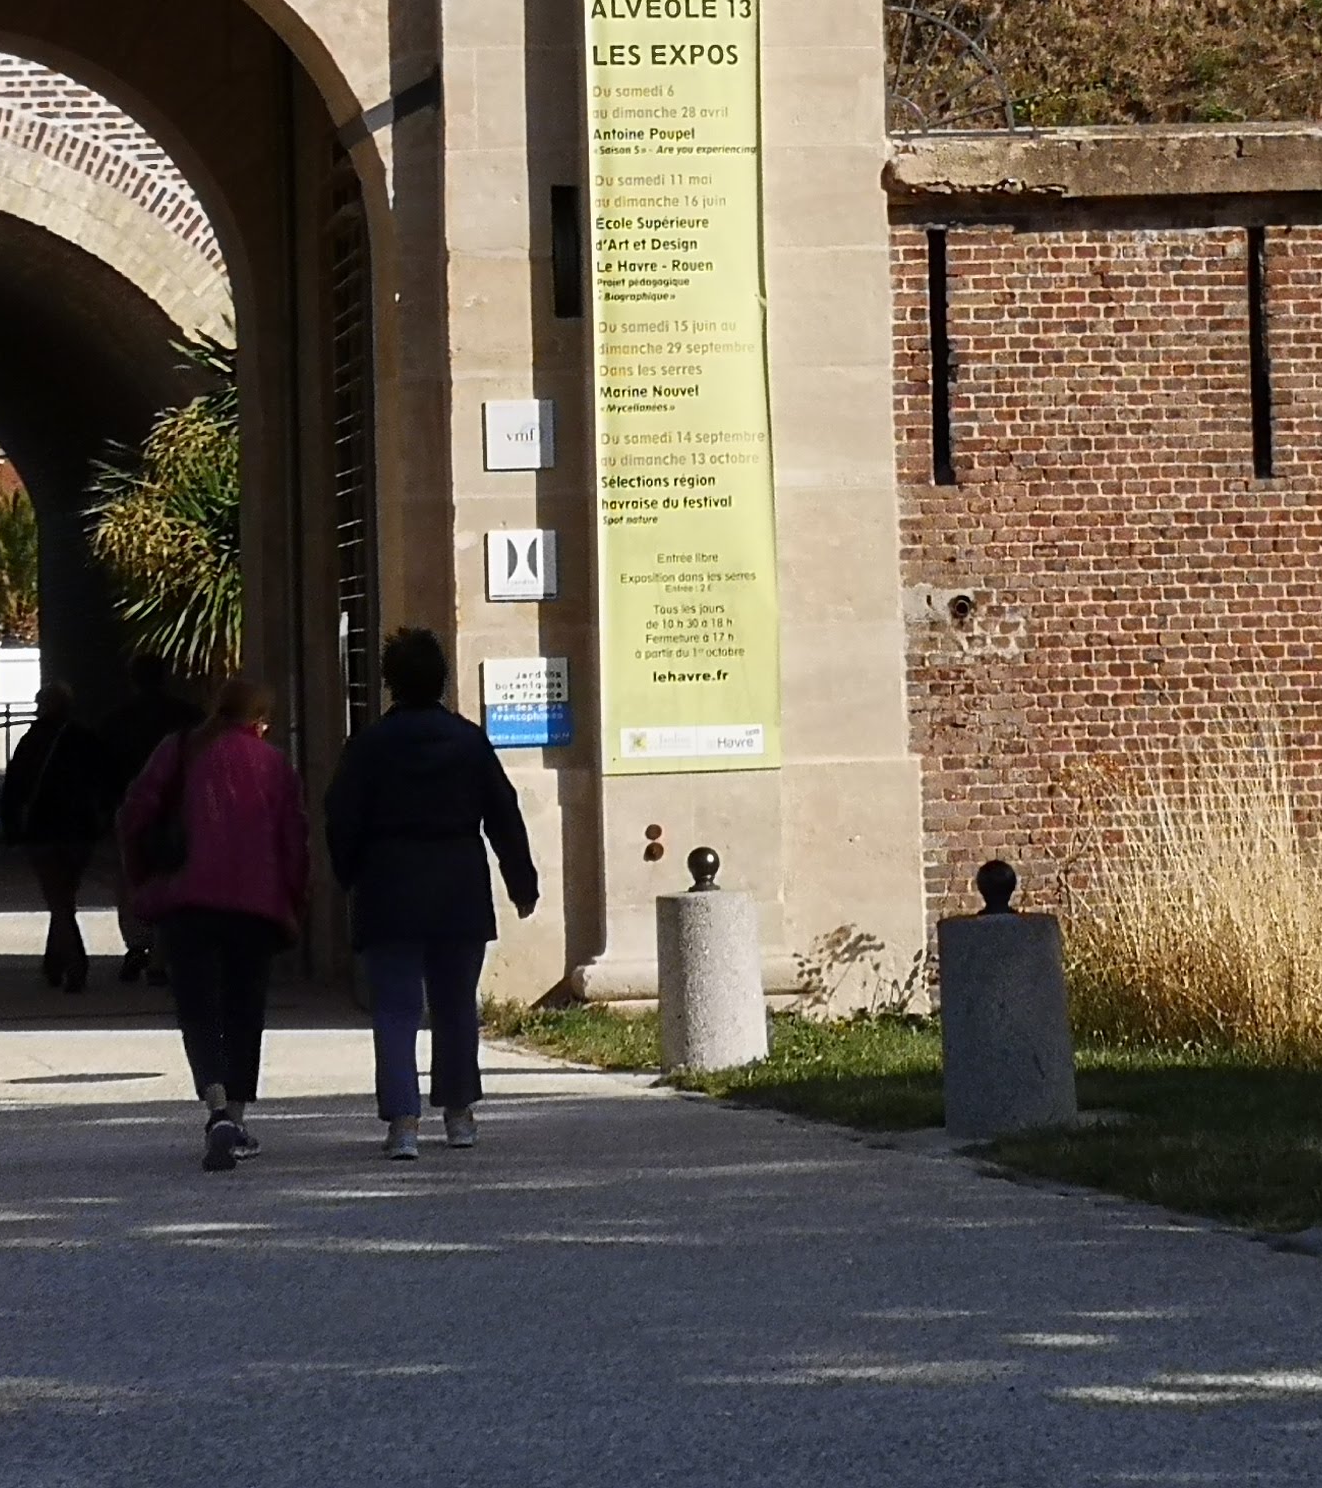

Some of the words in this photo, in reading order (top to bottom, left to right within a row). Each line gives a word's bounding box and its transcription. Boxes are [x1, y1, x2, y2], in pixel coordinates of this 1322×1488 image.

[593, 45, 641, 65] LES
[651, 44, 738, 65] EXPOS
[593, 86, 611, 97] Du
[615, 85, 663, 97] samedi
[667, 85, 674, 96] 6
[592, 108, 608, 119] au
[612, 106, 677, 119] dimanche
[681, 107, 696, 118] 28
[700, 107, 728, 118] avril
[594, 128, 644, 140] Antoine
[650, 128, 695, 141] Poupel
[656, 145, 674, 154] Are
[677, 146, 693, 155] you
[595, 175, 613, 186] Du
[618, 175, 665, 186] samedi
[670, 174, 684, 185] 11
[689, 174, 712, 185] mai
[595, 197, 610, 208] au
[614, 196, 679, 208] dimanche
[684, 195, 698, 206] 16
[702, 195, 726, 209] juin
[596, 215, 633, 230] École
[637, 216, 709, 230] Supérieure
[633, 239, 646, 250] et
[651, 238, 698, 252] Design
[597, 261, 612, 272] Le
[618, 261, 658, 272] Havre
[671, 259, 713, 272] Rouen
[629, 278, 690, 288] pédagogique
[599, 321, 617, 333] Du
[621, 320, 669, 332] samedi
[675, 320, 688, 331] 15
[692, 320, 716, 334] juin
[721, 321, 736, 331] au
[599, 343, 663, 355] dimanche
[667, 342, 681, 353] 29
[686, 341, 755, 355] septembre
[600, 365, 633, 376] Dans
[638, 365, 656, 376] les
[661, 365, 702, 375] serres
[600, 386, 647, 398] Marine
[653, 385, 699, 397] Nouvel
[601, 434, 619, 445] Du
[624, 432, 672, 444] samedi
[677, 432, 691, 443] 14
[696, 431, 765, 444] septembre
[601, 456, 616, 466] au
[620, 454, 686, 466] dimanche
[691, 453, 705, 464] 13
[710, 453, 759, 464] octobre
[601, 476, 669, 488] Sélections
[674, 475, 715, 489] région
[602, 498, 658, 509] havraise
[662, 497, 678, 508] du
[683, 496, 732, 508] festival
[603, 516, 623, 525] Spot
[627, 516, 658, 524] nature
[657, 553, 693, 563] Entrée
[695, 553, 719, 562] libre
[620, 573, 675, 584] Exposition
[678, 573, 704, 582] dans
[707, 572, 722, 581] les
[725, 572, 756, 581] serres
[654, 605, 678, 614] Tous
[681, 605, 696, 613] les
[699, 604, 725, 615] jours
[646, 620, 659, 629] de
[663, 620, 674, 629] 10
[677, 619, 683, 628] h
[687, 619, 699, 628] 30
[712, 618, 723, 627] 18
[727, 618, 732, 627] h
[646, 634, 699, 644] Fermeture
[713, 633, 725, 642] 17
[728, 632, 734, 641] h
[645, 648, 673, 660] partir
[676, 648, 689, 657] du
[706, 647, 745, 657] octobre
[653, 670, 729, 683] lehavre.fr
[717, 737, 754, 748] Havre
